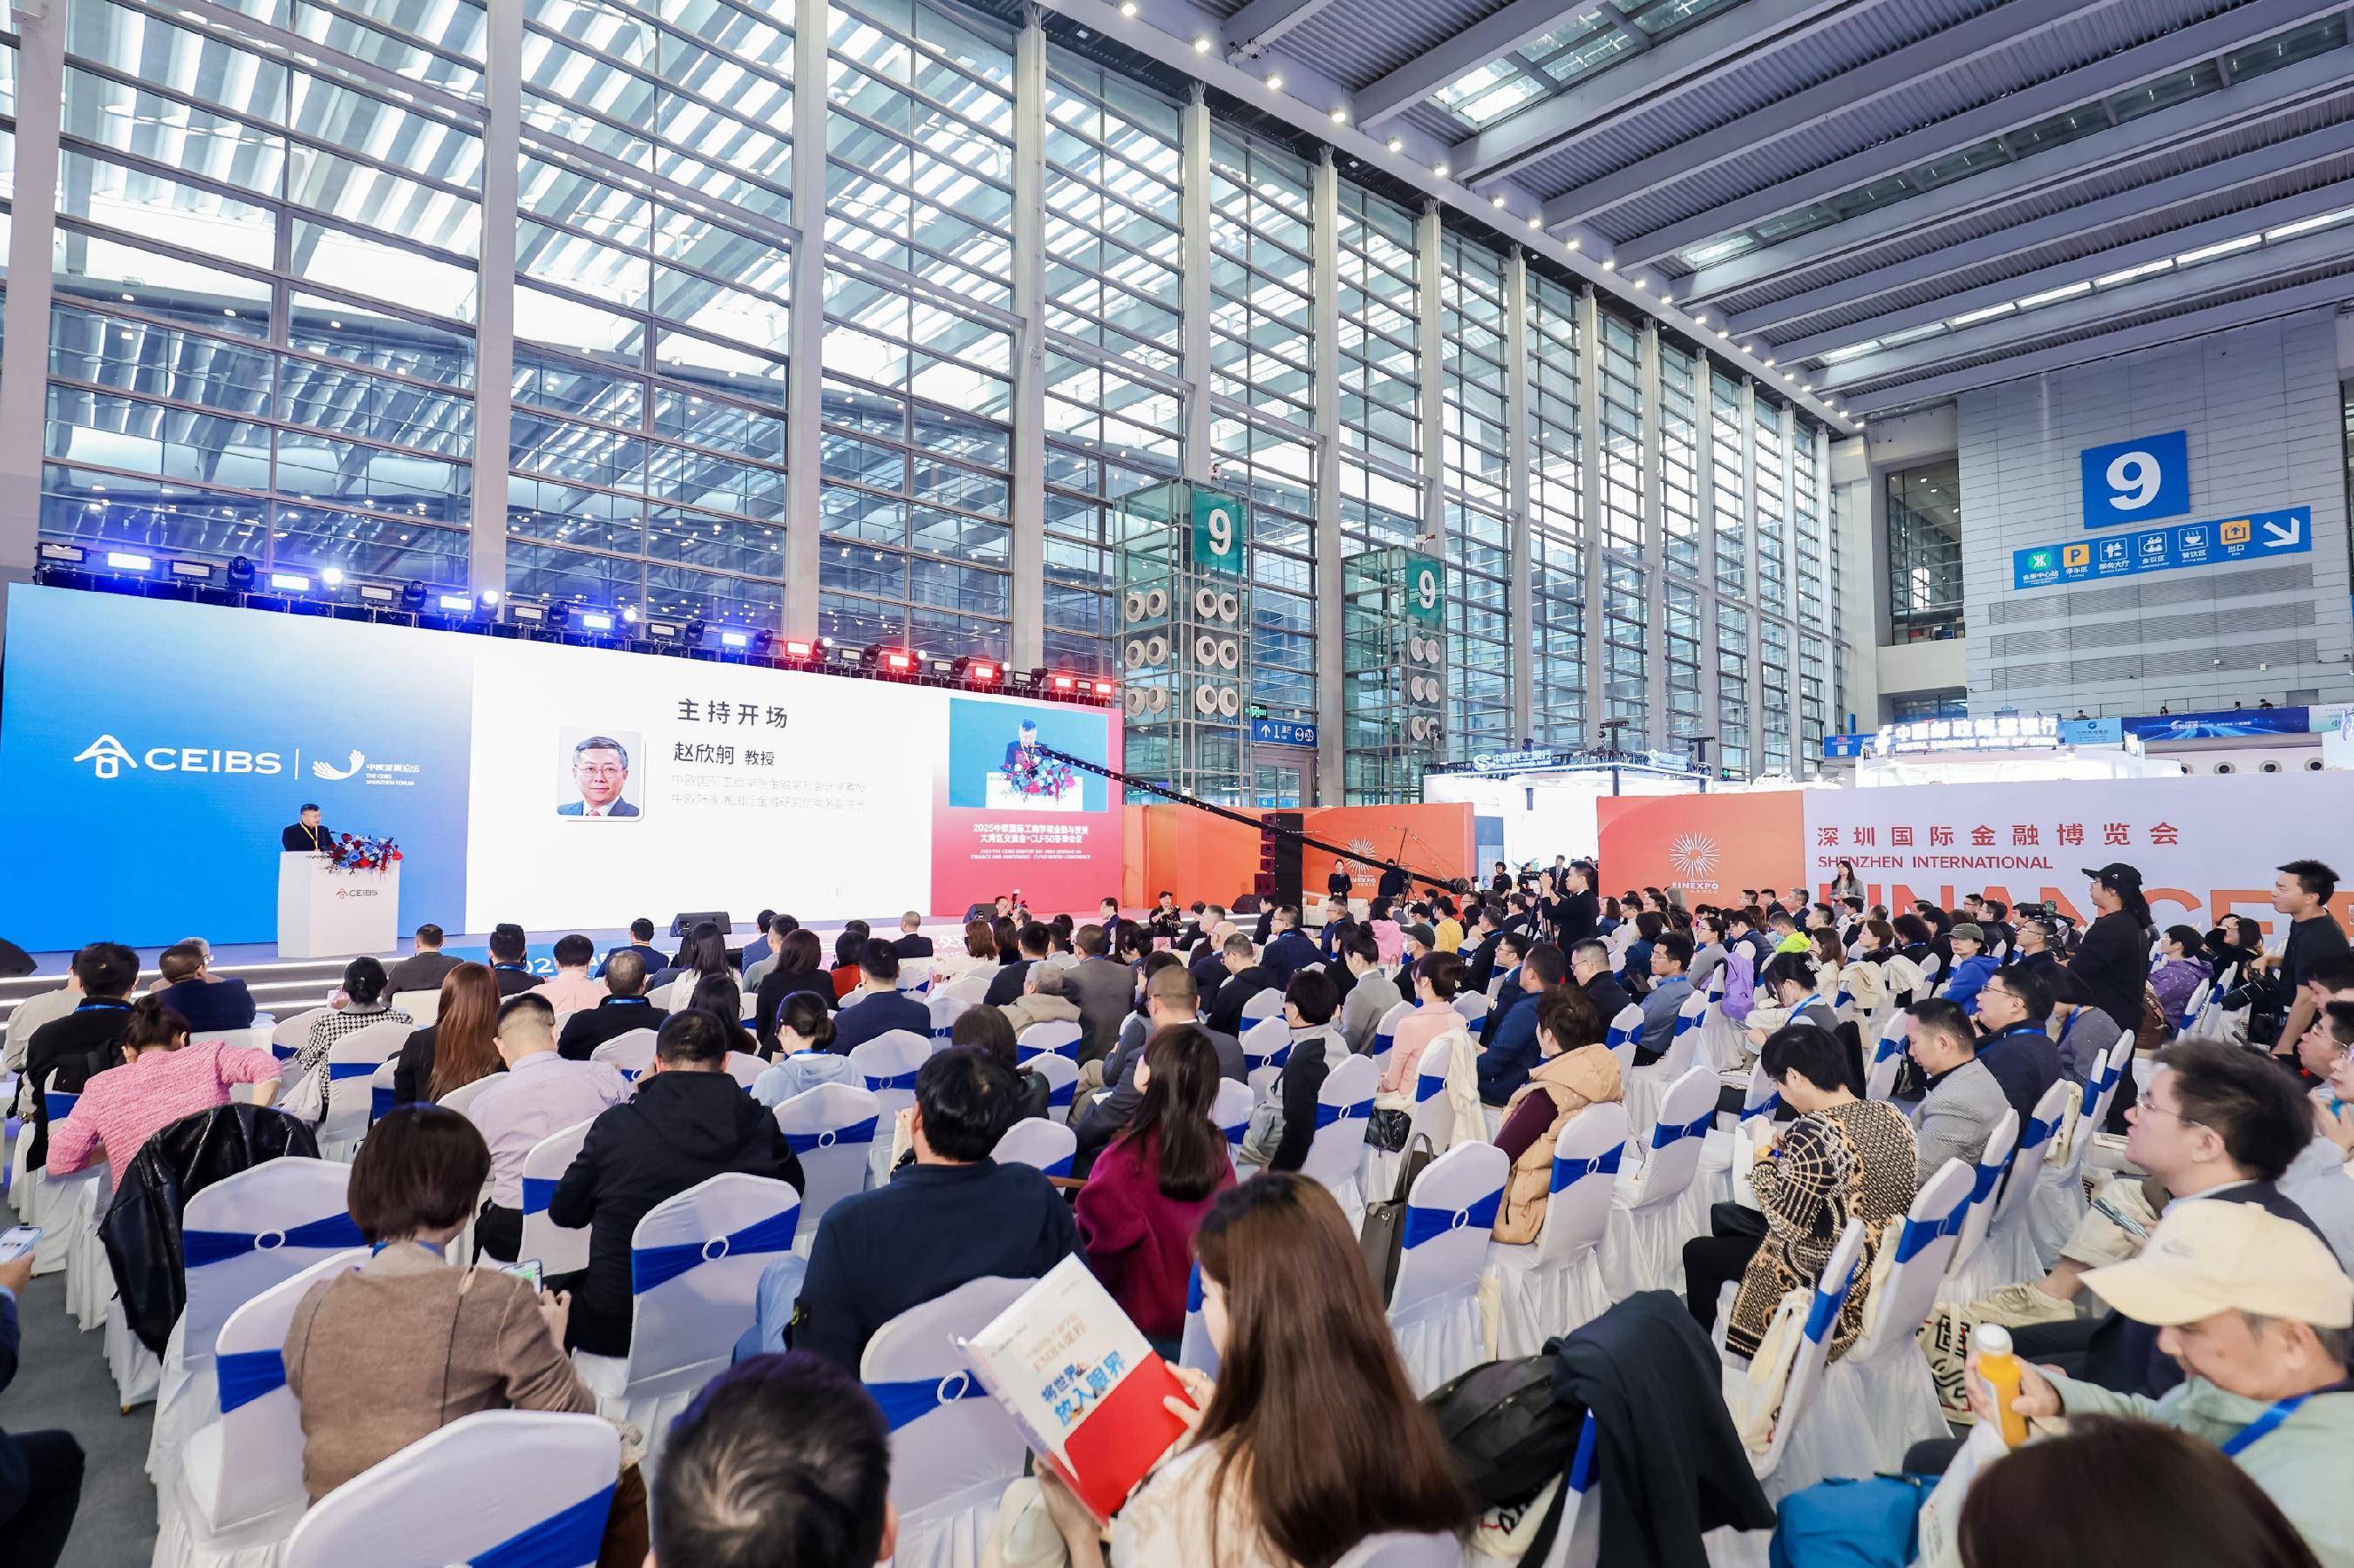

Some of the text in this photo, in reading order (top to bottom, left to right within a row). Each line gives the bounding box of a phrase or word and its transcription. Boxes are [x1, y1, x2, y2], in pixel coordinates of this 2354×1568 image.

[2106, 451, 2162, 510] 9
[1208, 508, 1231, 555] 9
[2142, 555, 2165, 564] 会议区
[2228, 544, 2245, 553] 出口
[1419, 569, 1435, 609] 9
[677, 698, 787, 729] 主持开场
[1274, 725, 1280, 739] 1
[145, 748, 282, 775] CEIBS
[674, 741, 774, 766] 赵欣舸 教授
[1817, 822, 2179, 847] 深圳国际金融博览会
[1913, 856, 2053, 869] INTERNATIONAL
[1041, 1363, 1076, 1403] 将世界
[1054, 1350, 1126, 1428] 放入眼界
